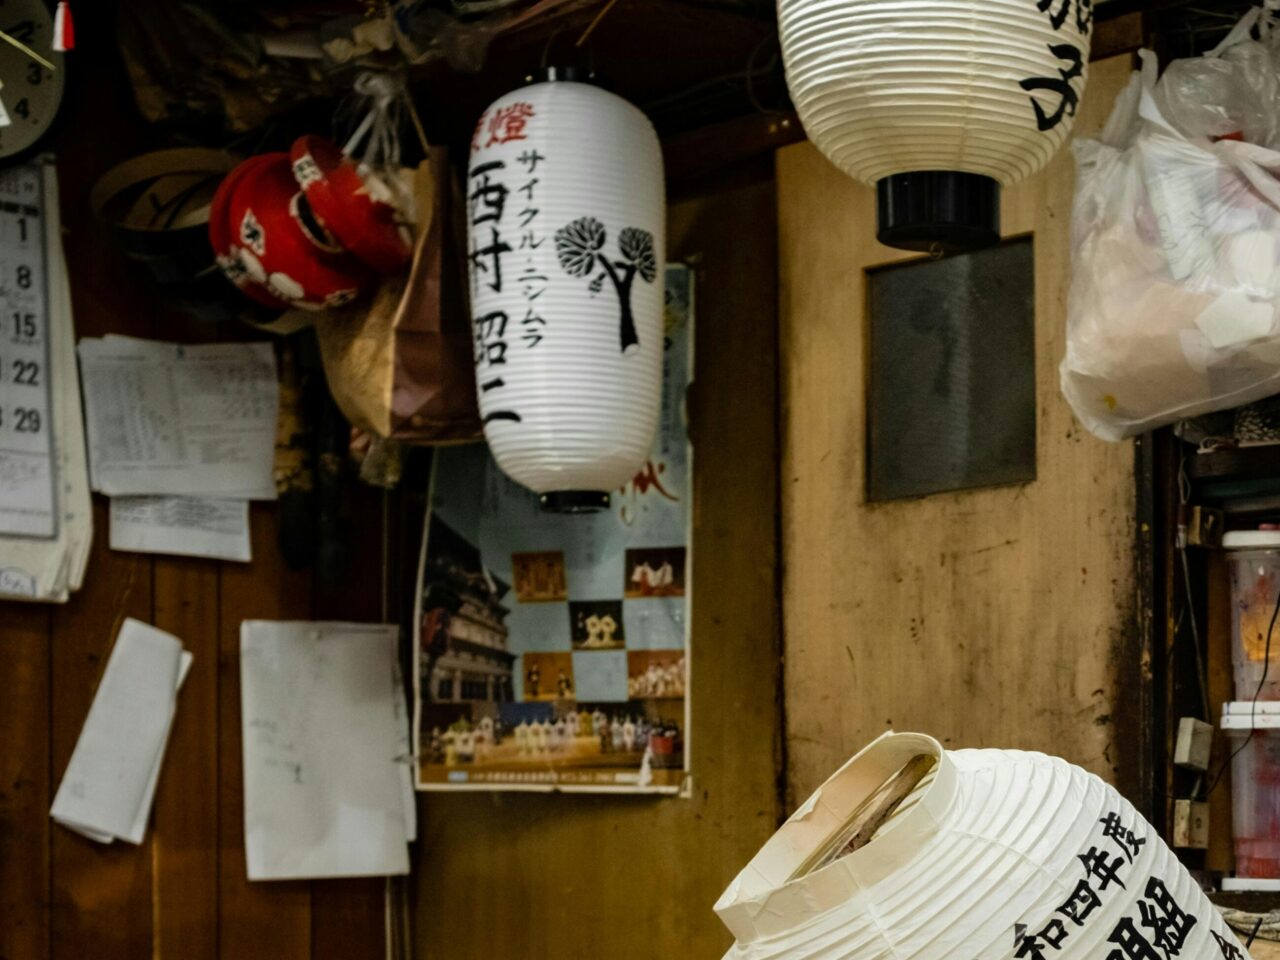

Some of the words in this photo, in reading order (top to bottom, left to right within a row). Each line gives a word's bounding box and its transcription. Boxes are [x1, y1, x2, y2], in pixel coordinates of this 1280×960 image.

[26, 62, 42, 85] 3
[14, 98, 30, 119] 4
[17, 218, 27, 241] 1
[16, 264, 32, 289] 8
[12, 312, 36, 337] 15
[13, 359, 40, 386] 22
[14, 407, 41, 433] 29
